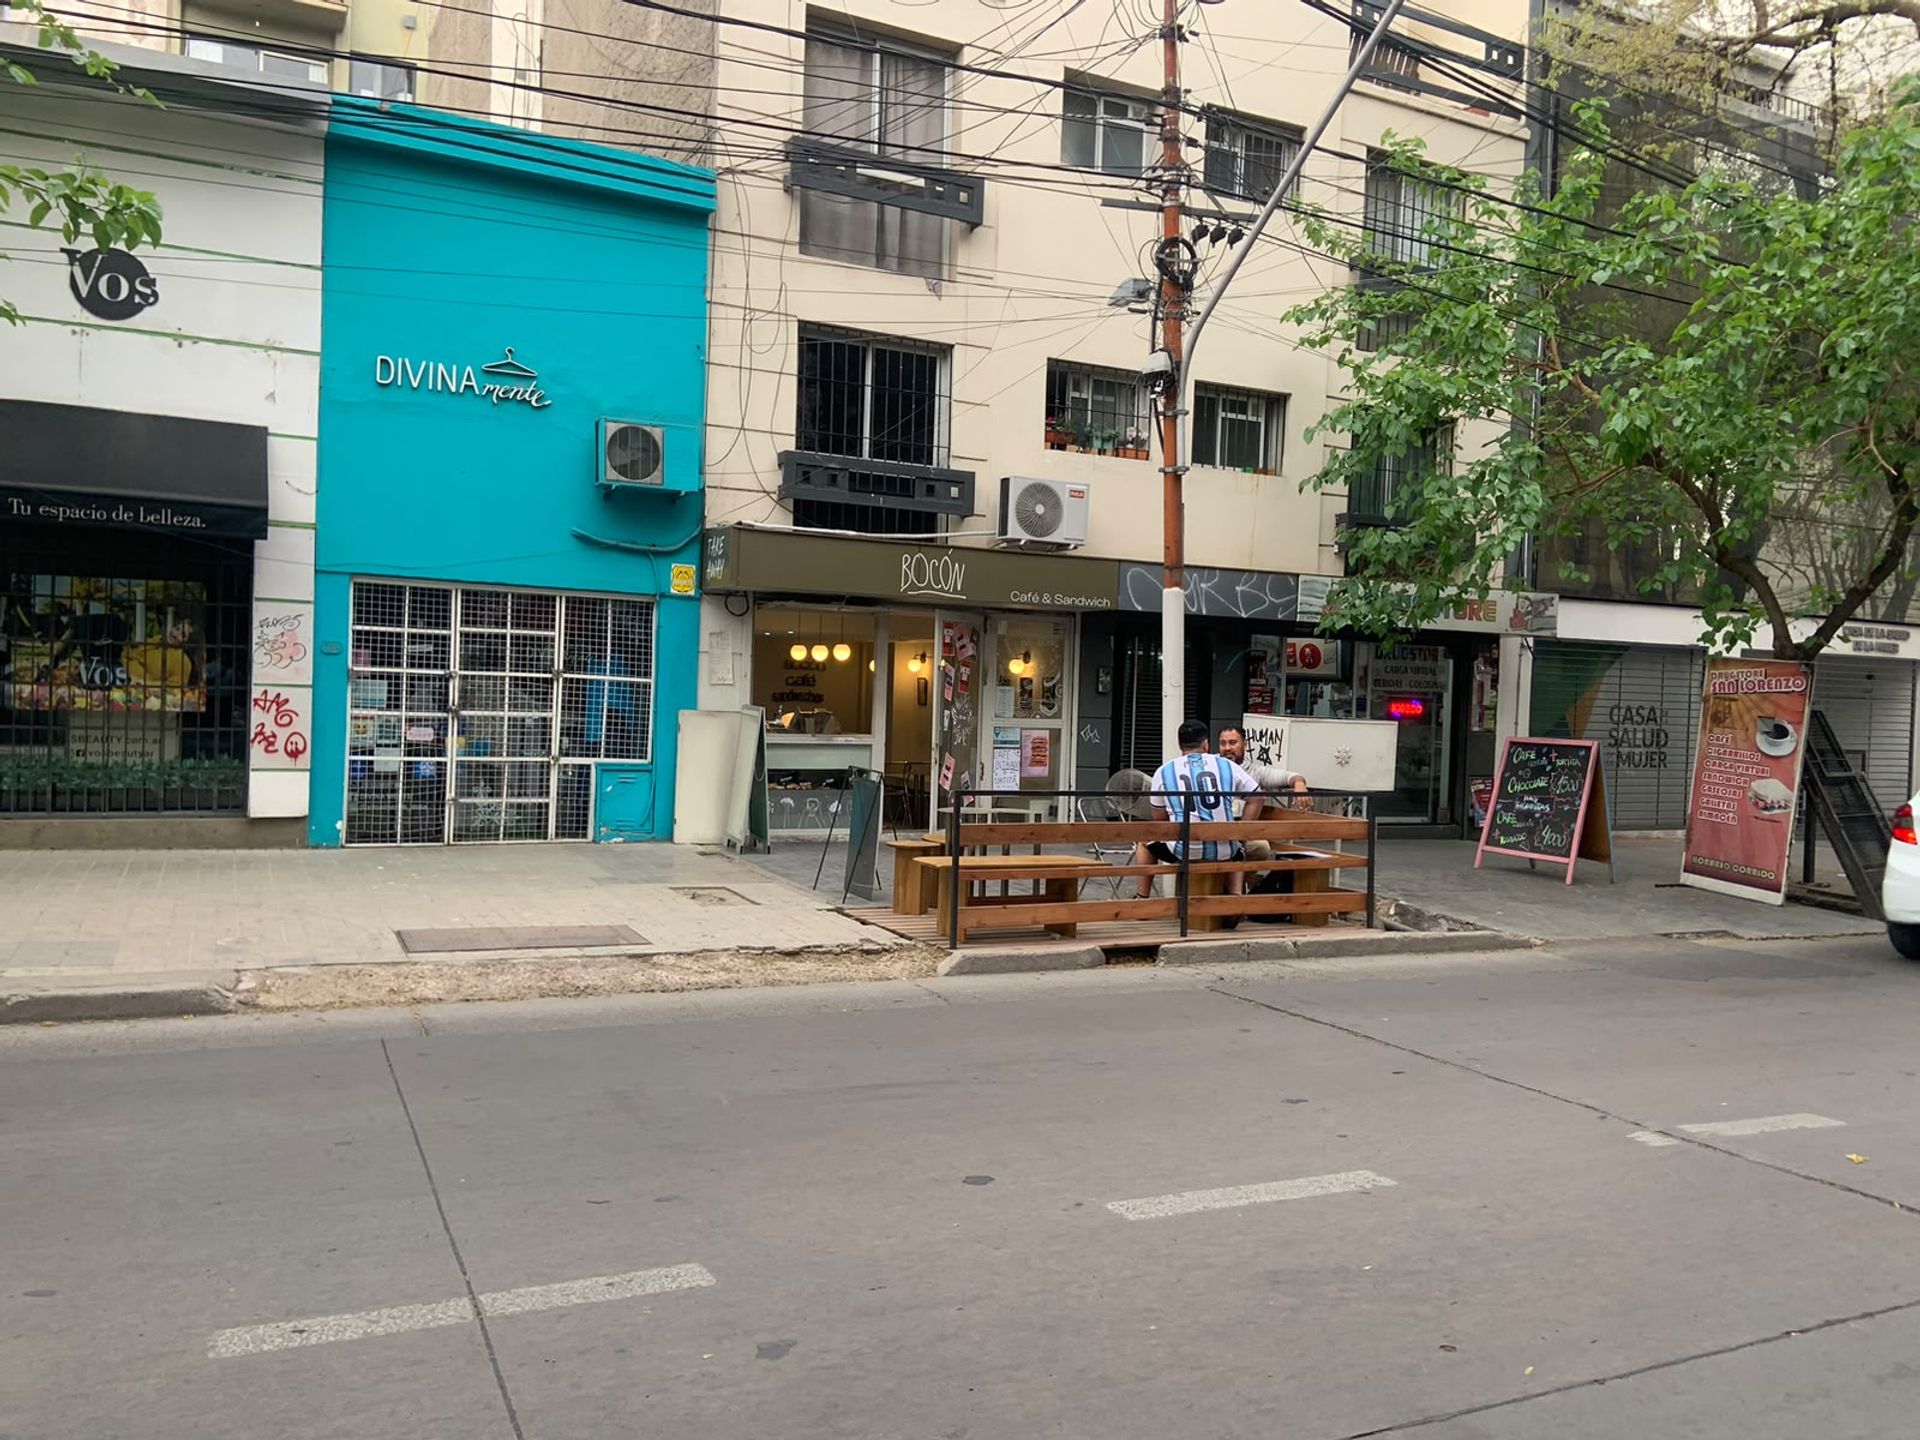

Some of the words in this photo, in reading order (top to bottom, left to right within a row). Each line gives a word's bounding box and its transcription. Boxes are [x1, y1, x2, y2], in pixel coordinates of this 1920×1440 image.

[60, 247, 160, 308] Vos
[376, 355, 479, 395] DIVINA
[481, 380, 552, 407] mente
[8, 498, 32, 516] Tu
[39, 504, 107, 522] espacio
[112, 504, 134, 522] de
[140, 506, 207, 528] belleza.
[900, 548, 966, 592] BOCÓN
[1010, 590, 1040, 604] Café
[1042, 592, 1053, 604] &
[1054, 593, 1111, 608] Sandwich
[1712, 680, 1736, 694] SAN
[1740, 678, 1806, 693] LORENZO
[1609, 705, 1658, 726] CASA
[1608, 727, 1669, 748] SALUD
[1616, 751, 1667, 768] MUJER
[1179, 771, 1221, 812] 10
